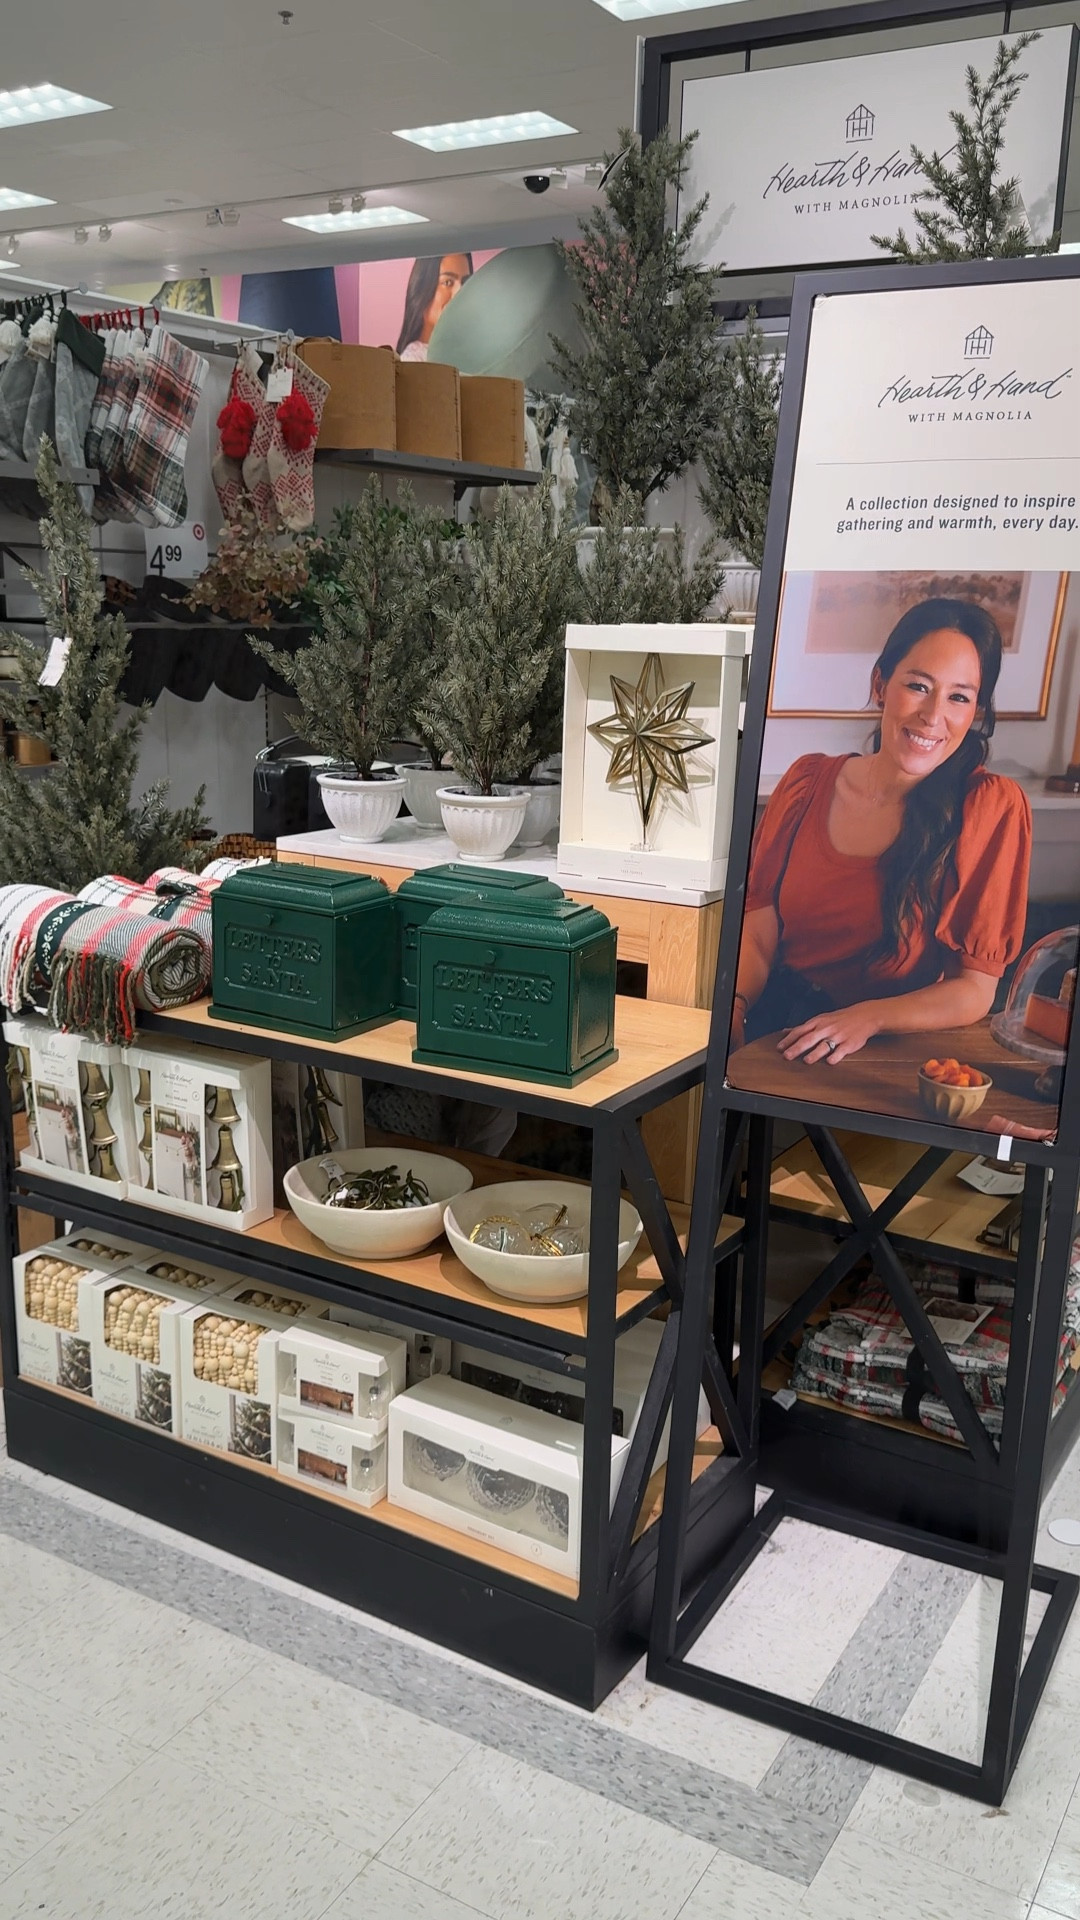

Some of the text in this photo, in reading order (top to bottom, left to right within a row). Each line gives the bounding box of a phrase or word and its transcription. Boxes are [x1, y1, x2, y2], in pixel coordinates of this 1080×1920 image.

[762, 150, 859, 200] Hearth
[852, 156, 871, 188] &
[794, 193, 919, 215] WITH MAGNOLIA
[877, 367, 1073, 409] Hearth & Hand
[908, 410, 1033, 423] WITH MAGNOLIA
[845, 493, 1076, 512] A collection designed to inspire
[836, 514, 1079, 534] gathering and warmth, every day.
[228, 926, 322, 965] LETTERS
[265, 953, 282, 969] TO
[241, 961, 311, 995] SANTA
[435, 964, 555, 1003] LETTERS
[482, 993, 504, 1011] TO
[450, 1002, 540, 1040] SANTA
